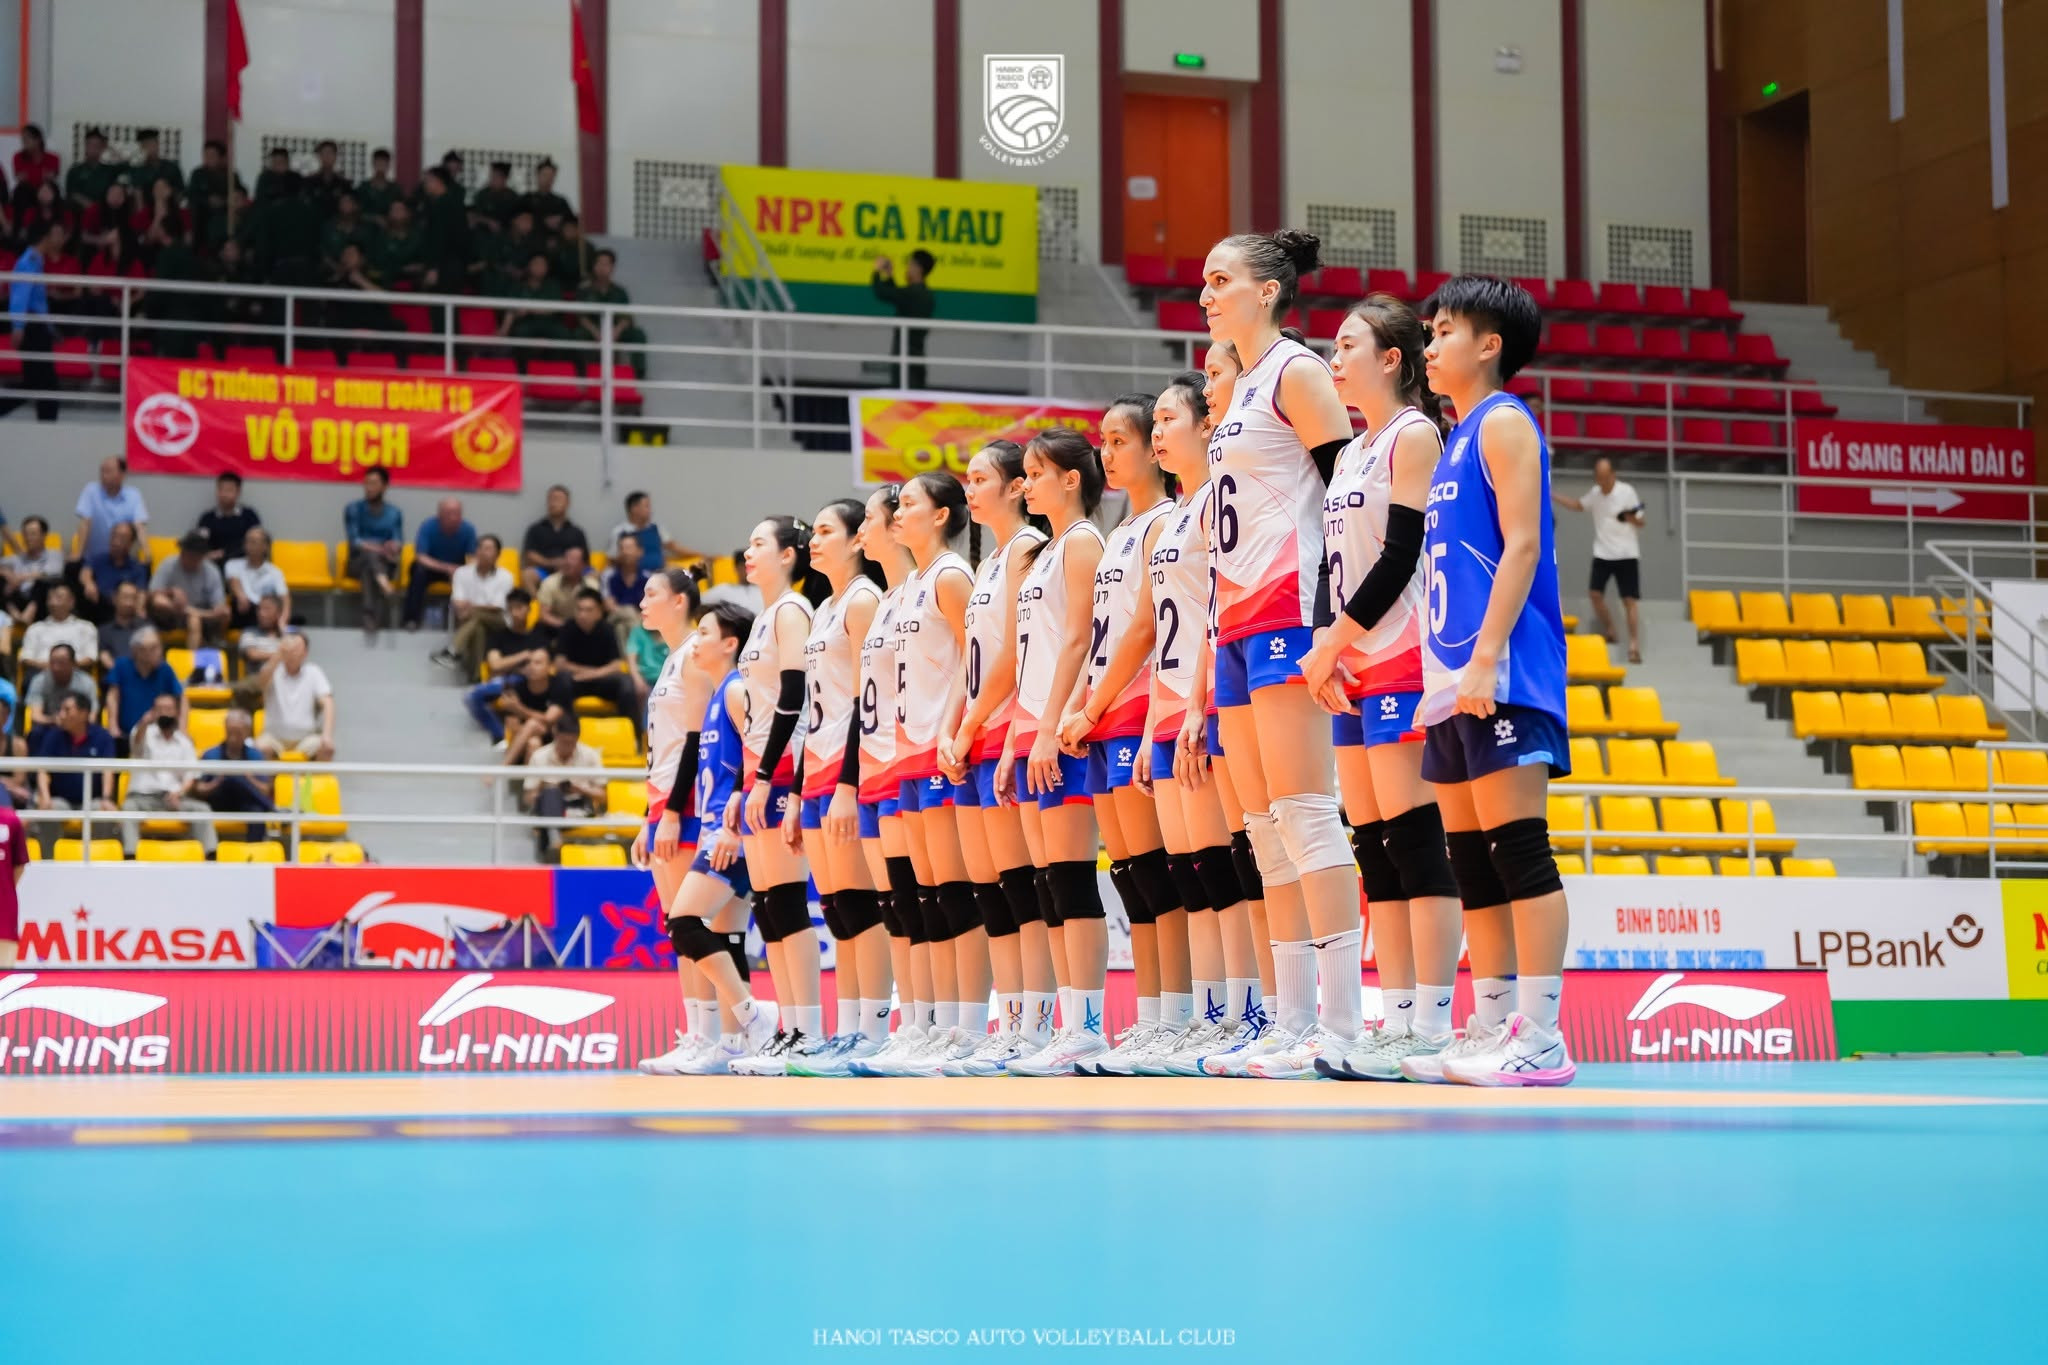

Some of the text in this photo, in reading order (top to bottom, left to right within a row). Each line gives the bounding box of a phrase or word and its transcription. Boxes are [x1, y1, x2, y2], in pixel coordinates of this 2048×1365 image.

[756, 194, 1004, 246] NPK CÀ MAU
[245, 408, 410, 475] VÔ ĐỊCH
[1210, 422, 1243, 445] SCO
[1808, 432, 2025, 478] LỐI SANG KHÁN ĐÀI C
[1324, 491, 1365, 514] ASCO
[1427, 481, 1459, 507] SCO
[1212, 474, 1239, 554] 6
[1325, 517, 1344, 538] UTO
[1017, 607, 1031, 623] UTO
[803, 640, 826, 656] ASCO
[1153, 598, 1180, 671] 2
[1616, 908, 1652, 934] BINH
[1703, 909, 1721, 934] 19
[1794, 930, 1946, 968] LPBank
[0, 1034, 170, 1068] I-NING
[419, 1032, 619, 1064] LI-NING
[1631, 1028, 1793, 1056] LI-NING
